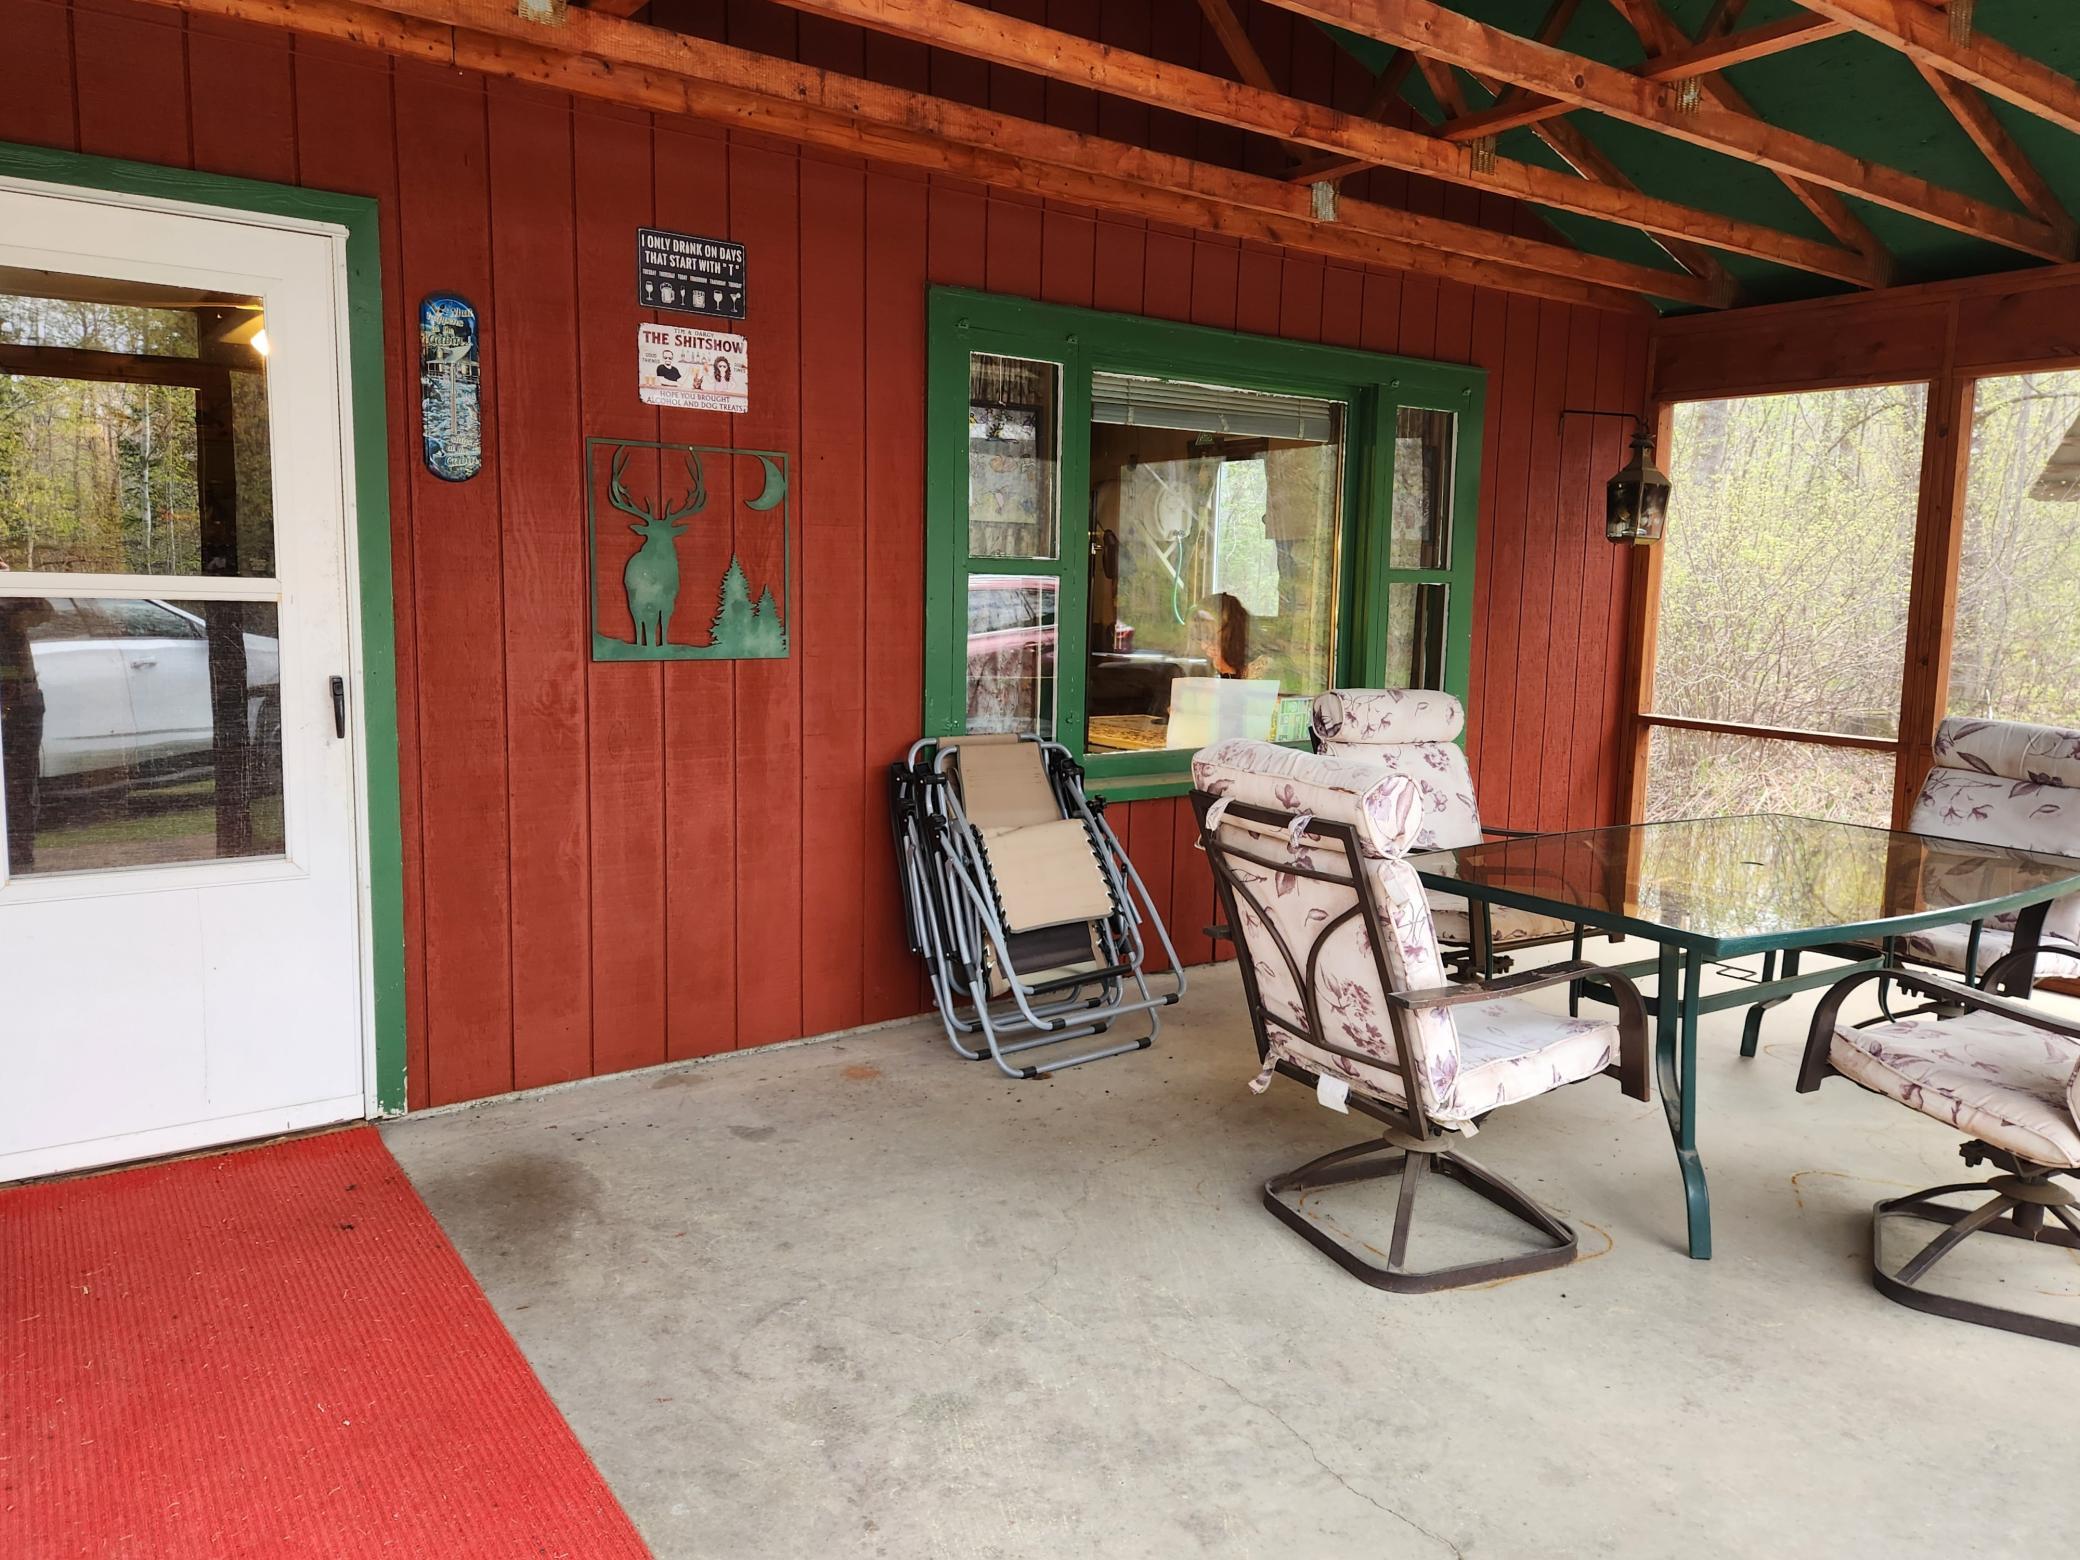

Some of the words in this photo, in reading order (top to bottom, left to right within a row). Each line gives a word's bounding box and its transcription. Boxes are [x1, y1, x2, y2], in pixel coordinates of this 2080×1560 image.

[641, 234, 645, 247] I
[647, 235, 671, 251] ONLY
[673, 239, 703, 256] DRINK
[704, 245, 717, 259] ON
[719, 247, 742, 263] DAYS
[644, 250, 668, 266] THAT
[669, 254, 697, 271] START
[699, 259, 721, 274] WITH
[642, 331, 670, 346] THE
[674, 334, 744, 354] SHITSHOW
[646, 396, 681, 406] ALCOHOL
[683, 399, 699, 408] AND
[701, 401, 718, 409] DOG
[719, 403, 743, 412] TREATS
[660, 390, 679, 398] HOPE
[681, 391, 695, 400] YOU
[697, 393, 730, 403] BROUGHT
